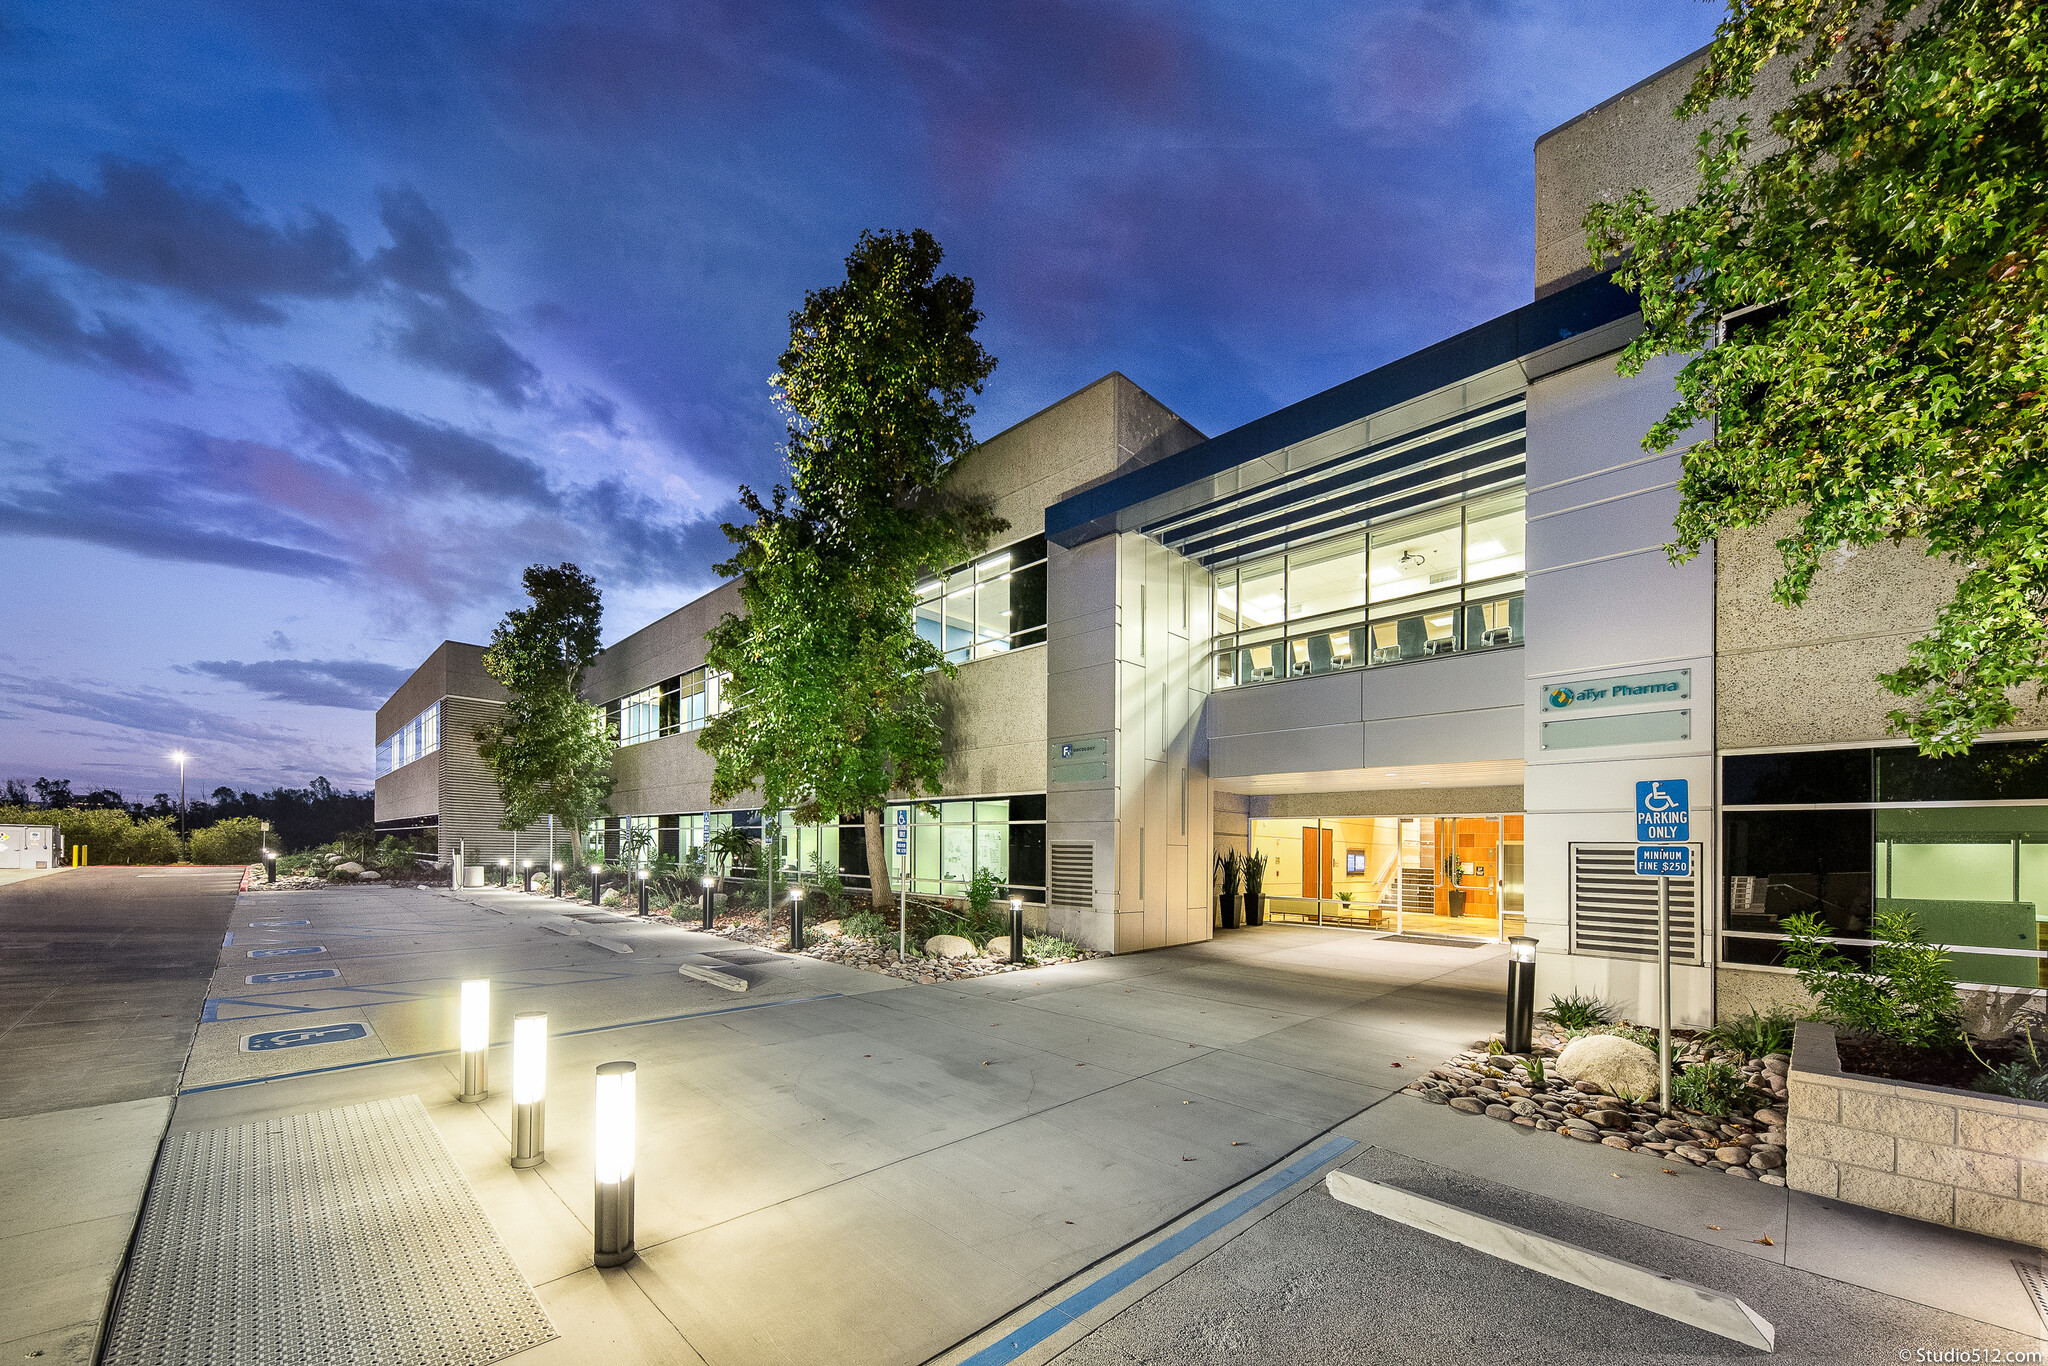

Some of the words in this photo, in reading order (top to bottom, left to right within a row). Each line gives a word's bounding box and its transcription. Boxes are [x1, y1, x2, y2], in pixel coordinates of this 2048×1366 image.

[1577, 688, 1607, 702] aTyr
[1613, 681, 1678, 697] Pharma
[1638, 811, 1687, 824] PARKING
[1649, 826, 1677, 838] ONLY
[1644, 851, 1682, 860] MINIMUM
[1639, 862, 1658, 870] FINE
[1662, 862, 1687, 871] $250
